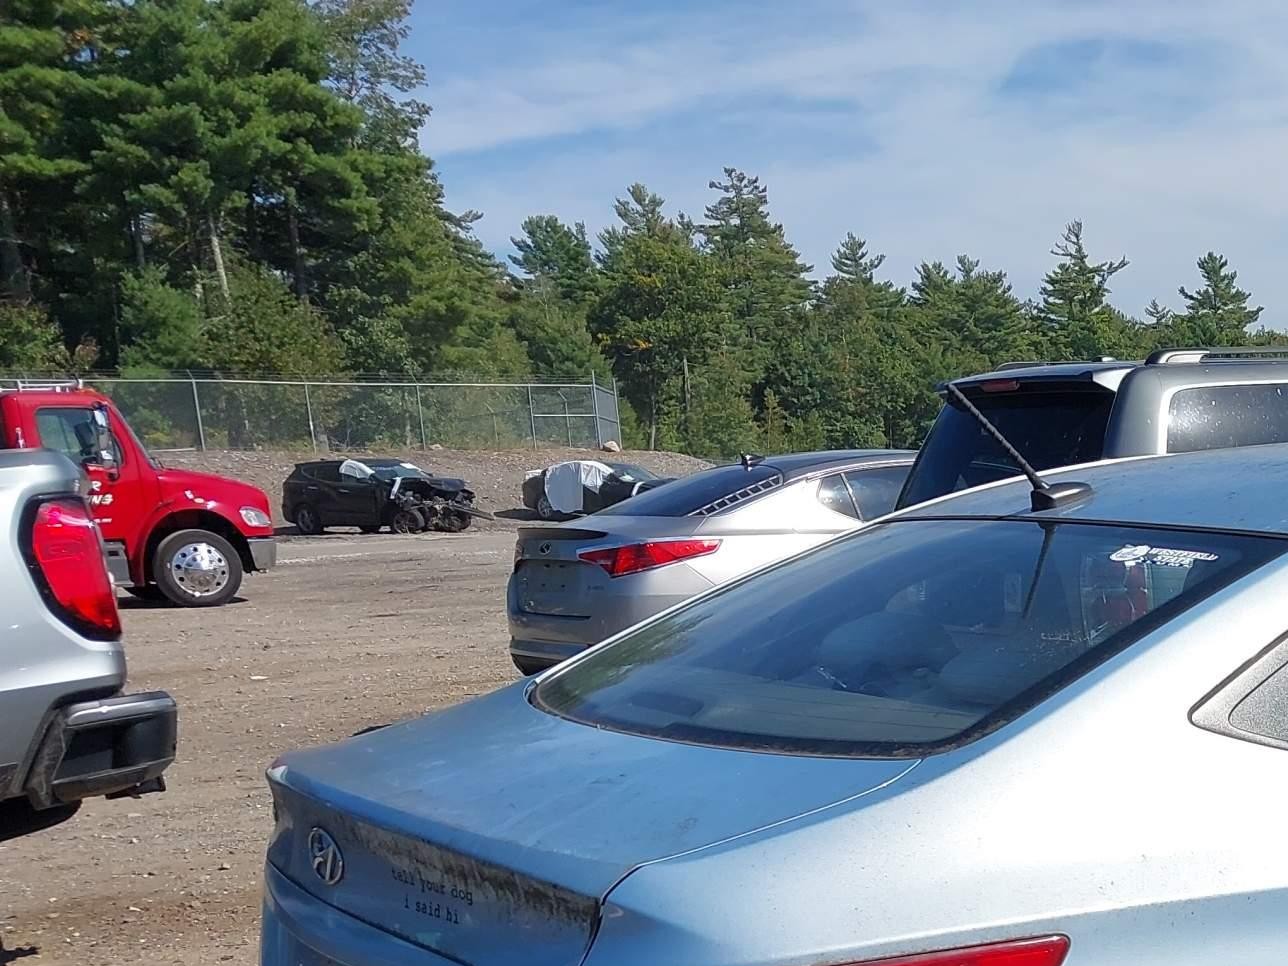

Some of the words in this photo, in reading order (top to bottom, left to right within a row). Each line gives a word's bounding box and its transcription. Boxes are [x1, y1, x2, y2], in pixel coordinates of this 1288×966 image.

[450, 885, 473, 905] dog
[415, 901, 441, 918] said
[446, 907, 460, 924] hi
